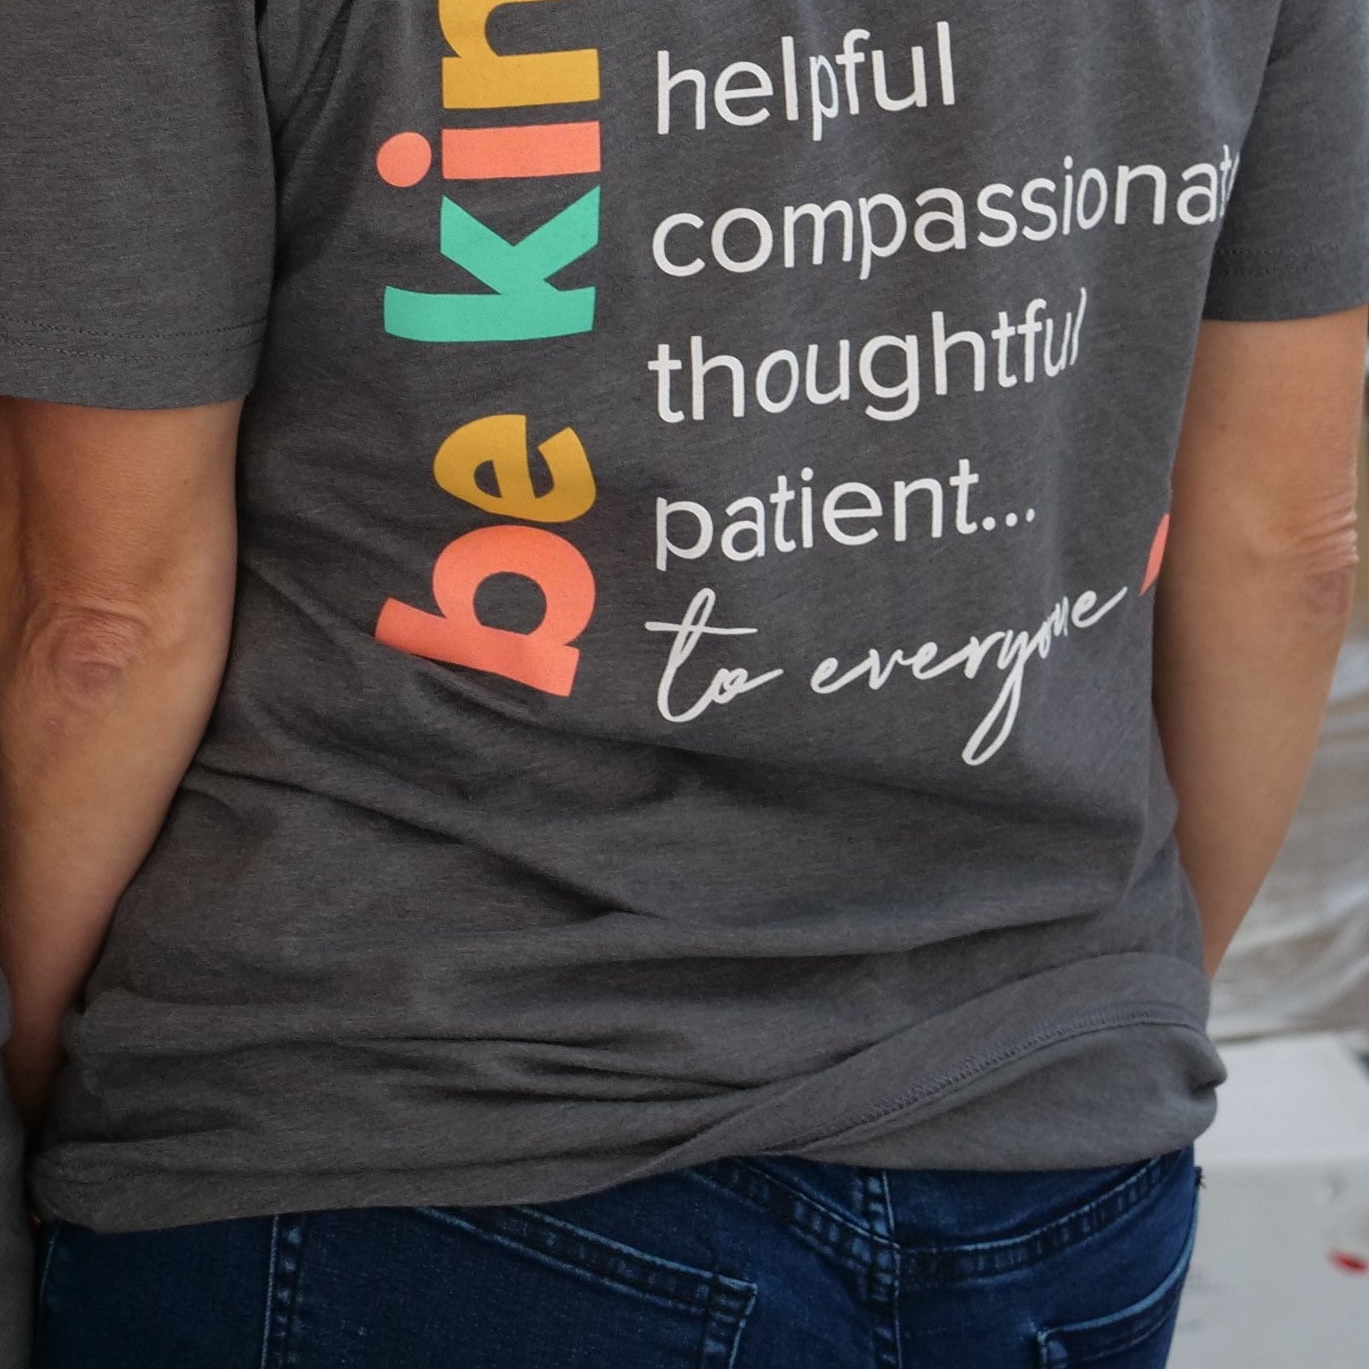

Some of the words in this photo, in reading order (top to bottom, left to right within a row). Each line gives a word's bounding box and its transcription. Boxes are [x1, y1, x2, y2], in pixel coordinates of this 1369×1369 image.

[657, 20, 956, 142] helpful
[647, 286, 1089, 424] thoughtful
[373, 412, 598, 699] be
[655, 458, 1036, 572] patient...
[645, 587, 784, 723] to
[809, 586, 1128, 766] everyone
